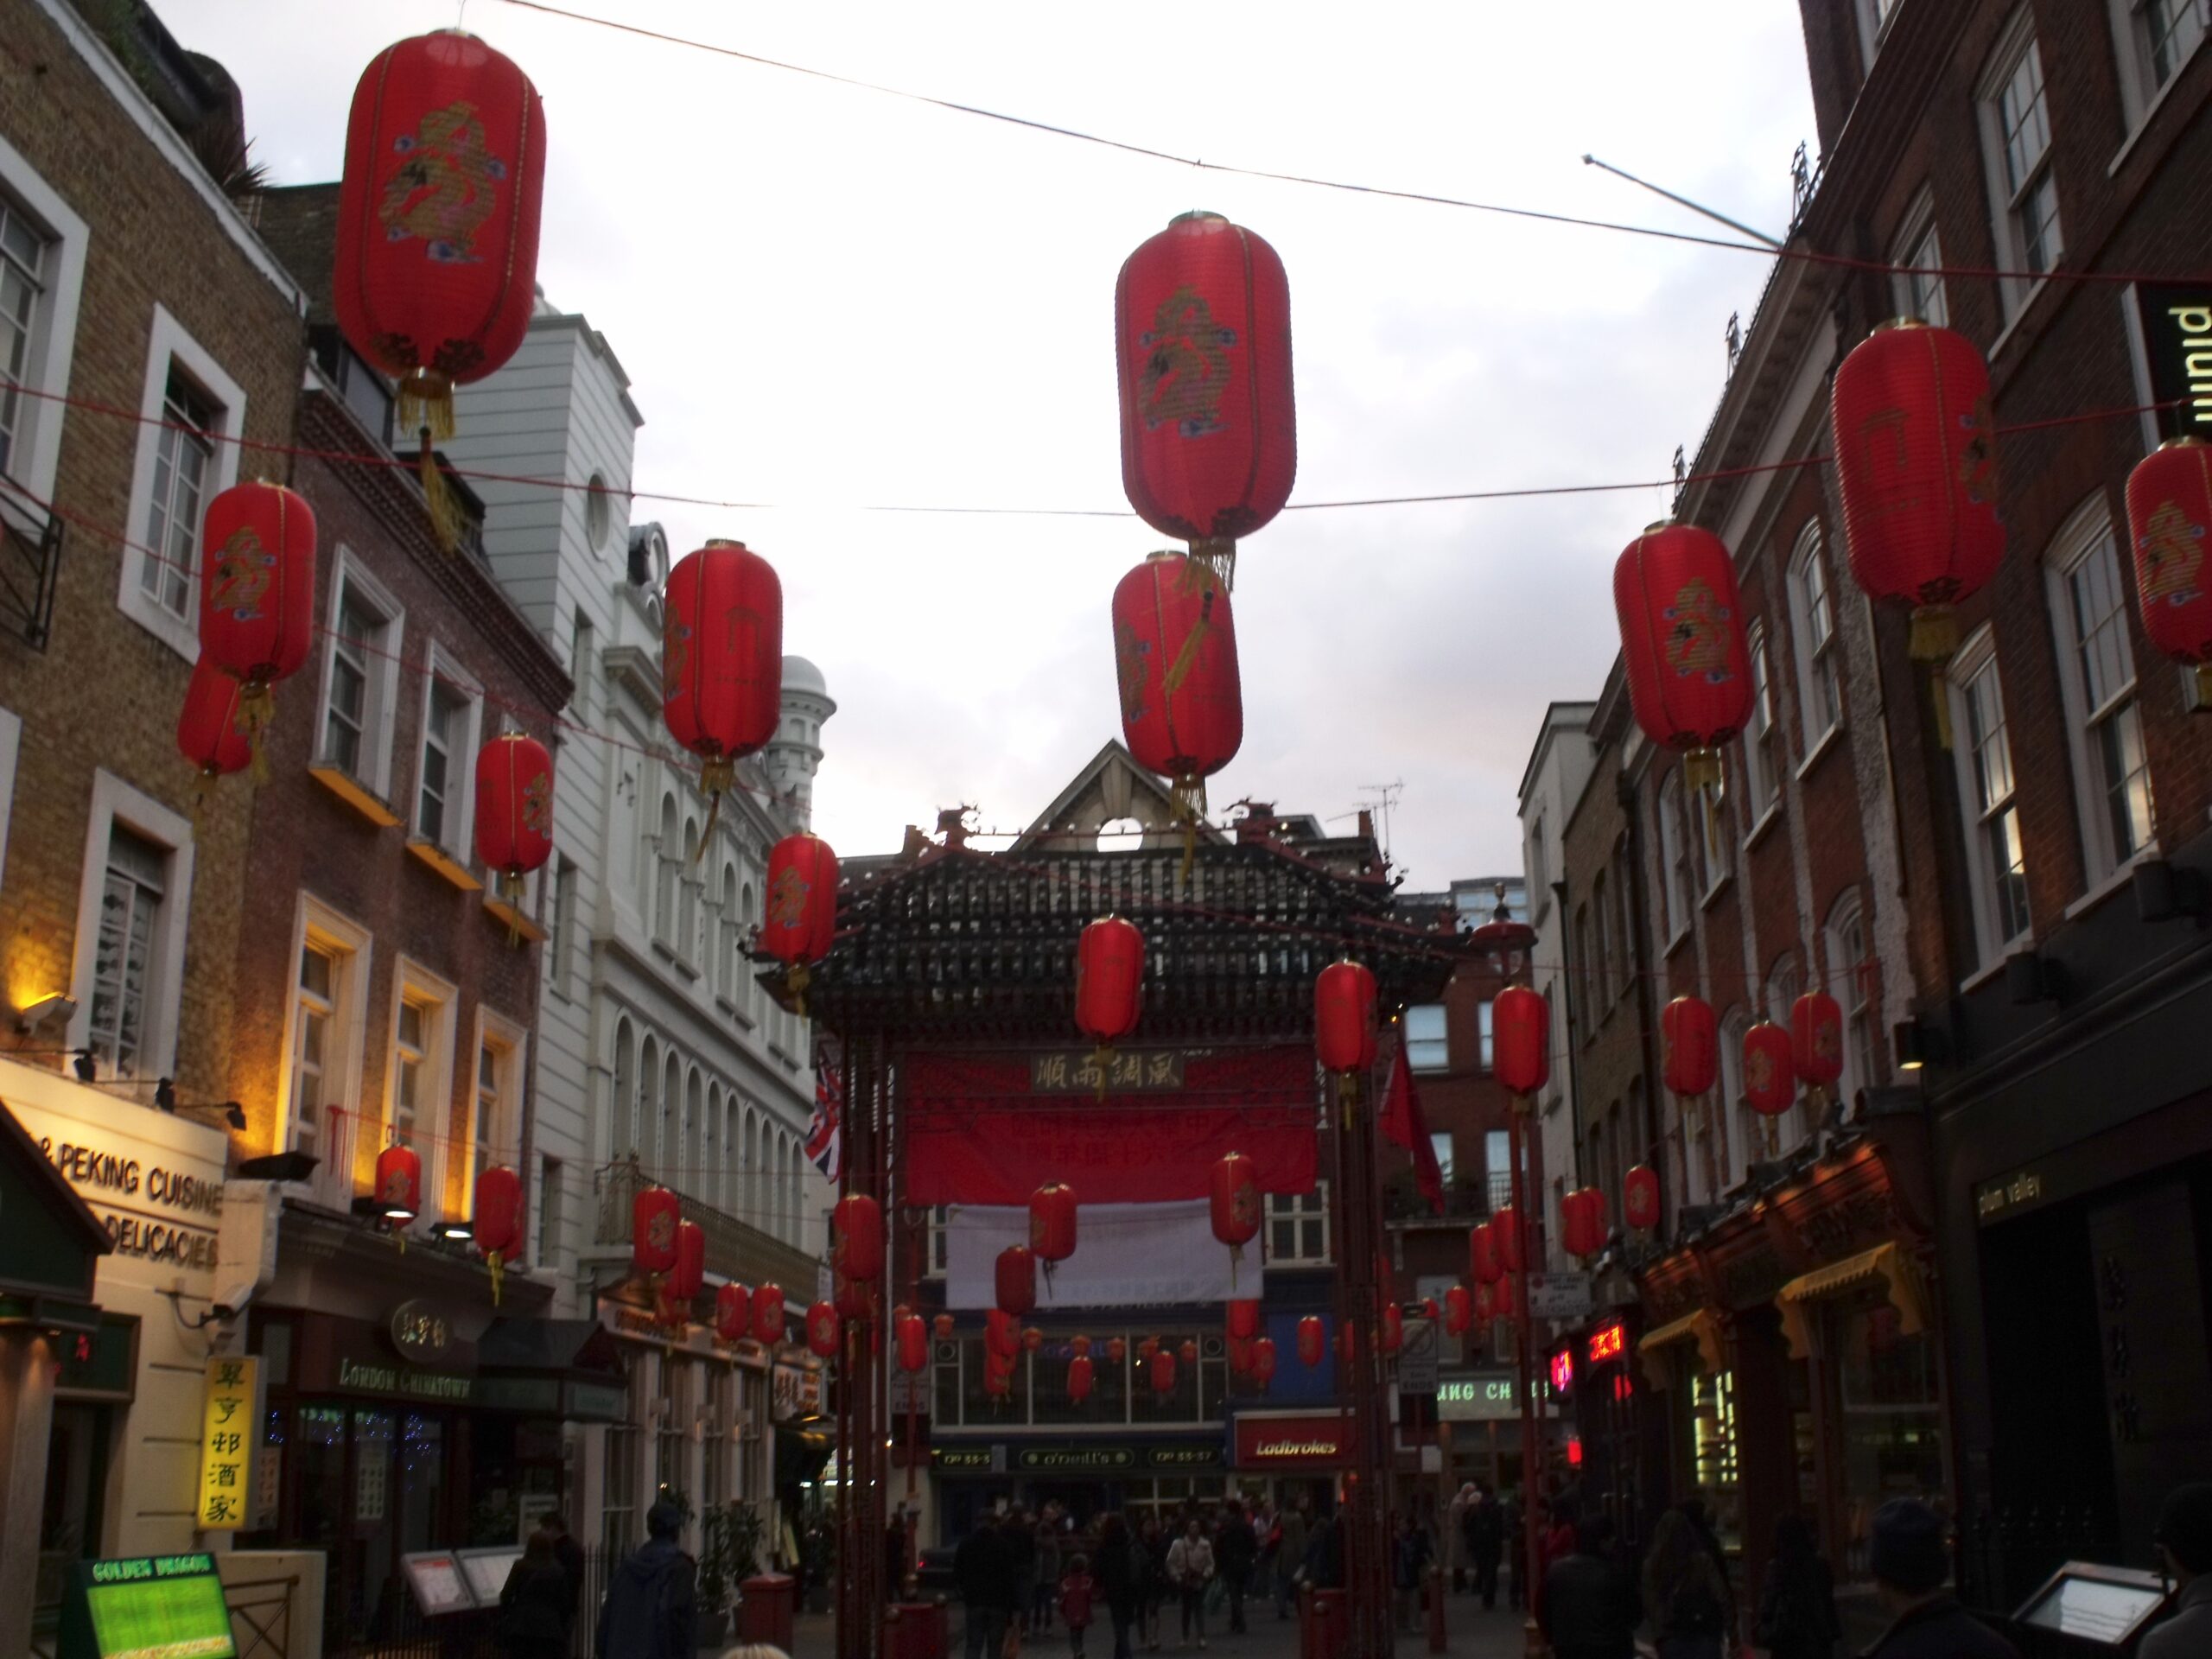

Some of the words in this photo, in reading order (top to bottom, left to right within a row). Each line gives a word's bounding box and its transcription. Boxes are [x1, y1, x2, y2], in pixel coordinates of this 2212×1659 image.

[60, 1143, 139, 1194] PEKING
[149, 1167, 224, 1213] CUISINE
[2006, 1173, 2040, 1203] valley
[105, 1216, 219, 1268] DELICACIES
[340, 1358, 396, 1391] LONDON
[400, 1369, 471, 1398] CHINATOWN
[1255, 1439, 1337, 1456] Ladbrokes
[92, 1559, 154, 1582] GOLDEN
